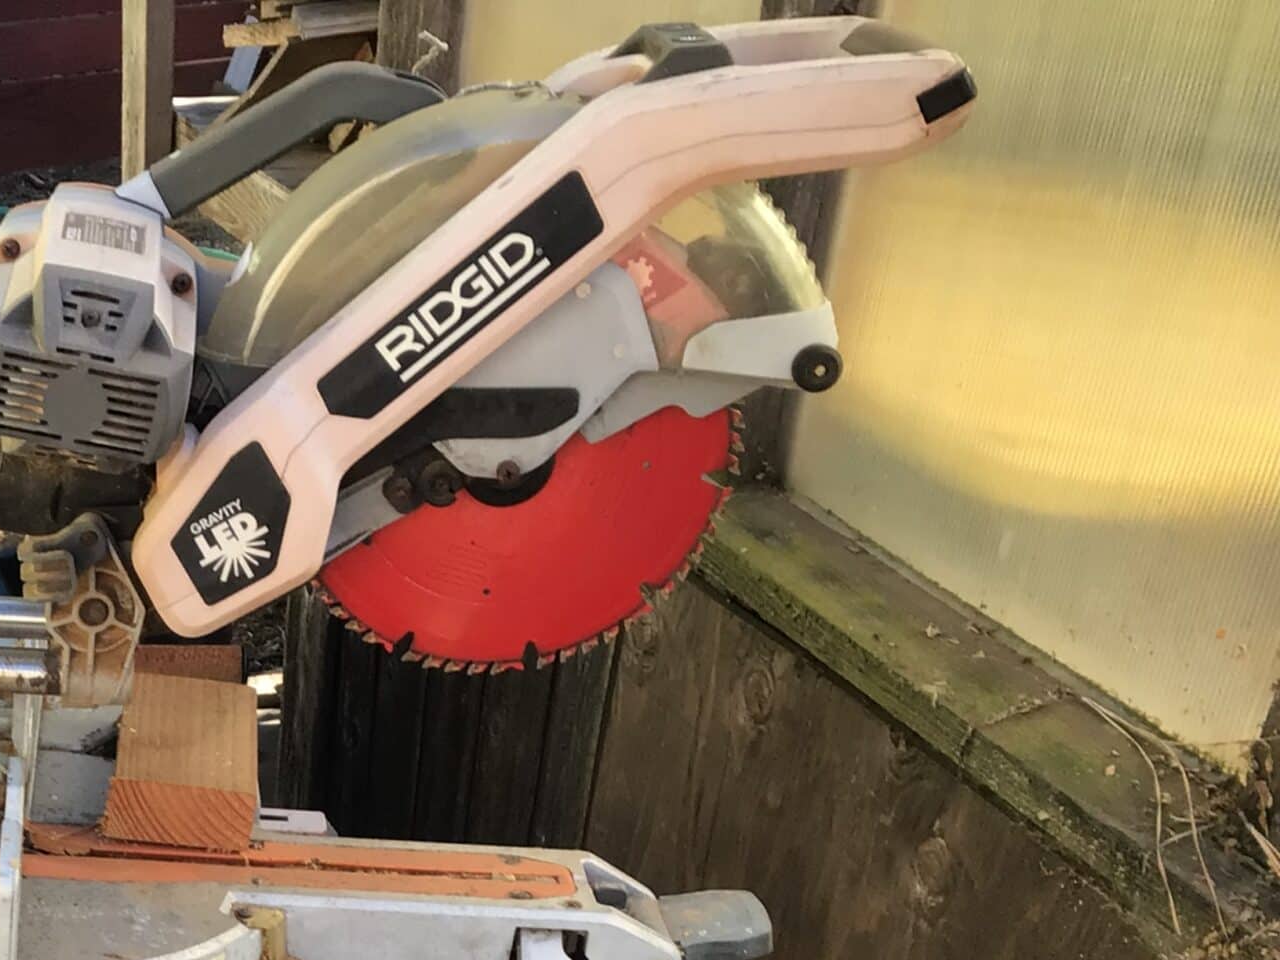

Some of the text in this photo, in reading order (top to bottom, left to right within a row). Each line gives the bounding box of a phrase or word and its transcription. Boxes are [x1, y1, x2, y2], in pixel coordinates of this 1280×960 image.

[375, 232, 535, 372] RIDGID
[190, 498, 242, 535] GRAVITY
[194, 512, 268, 568] LED
